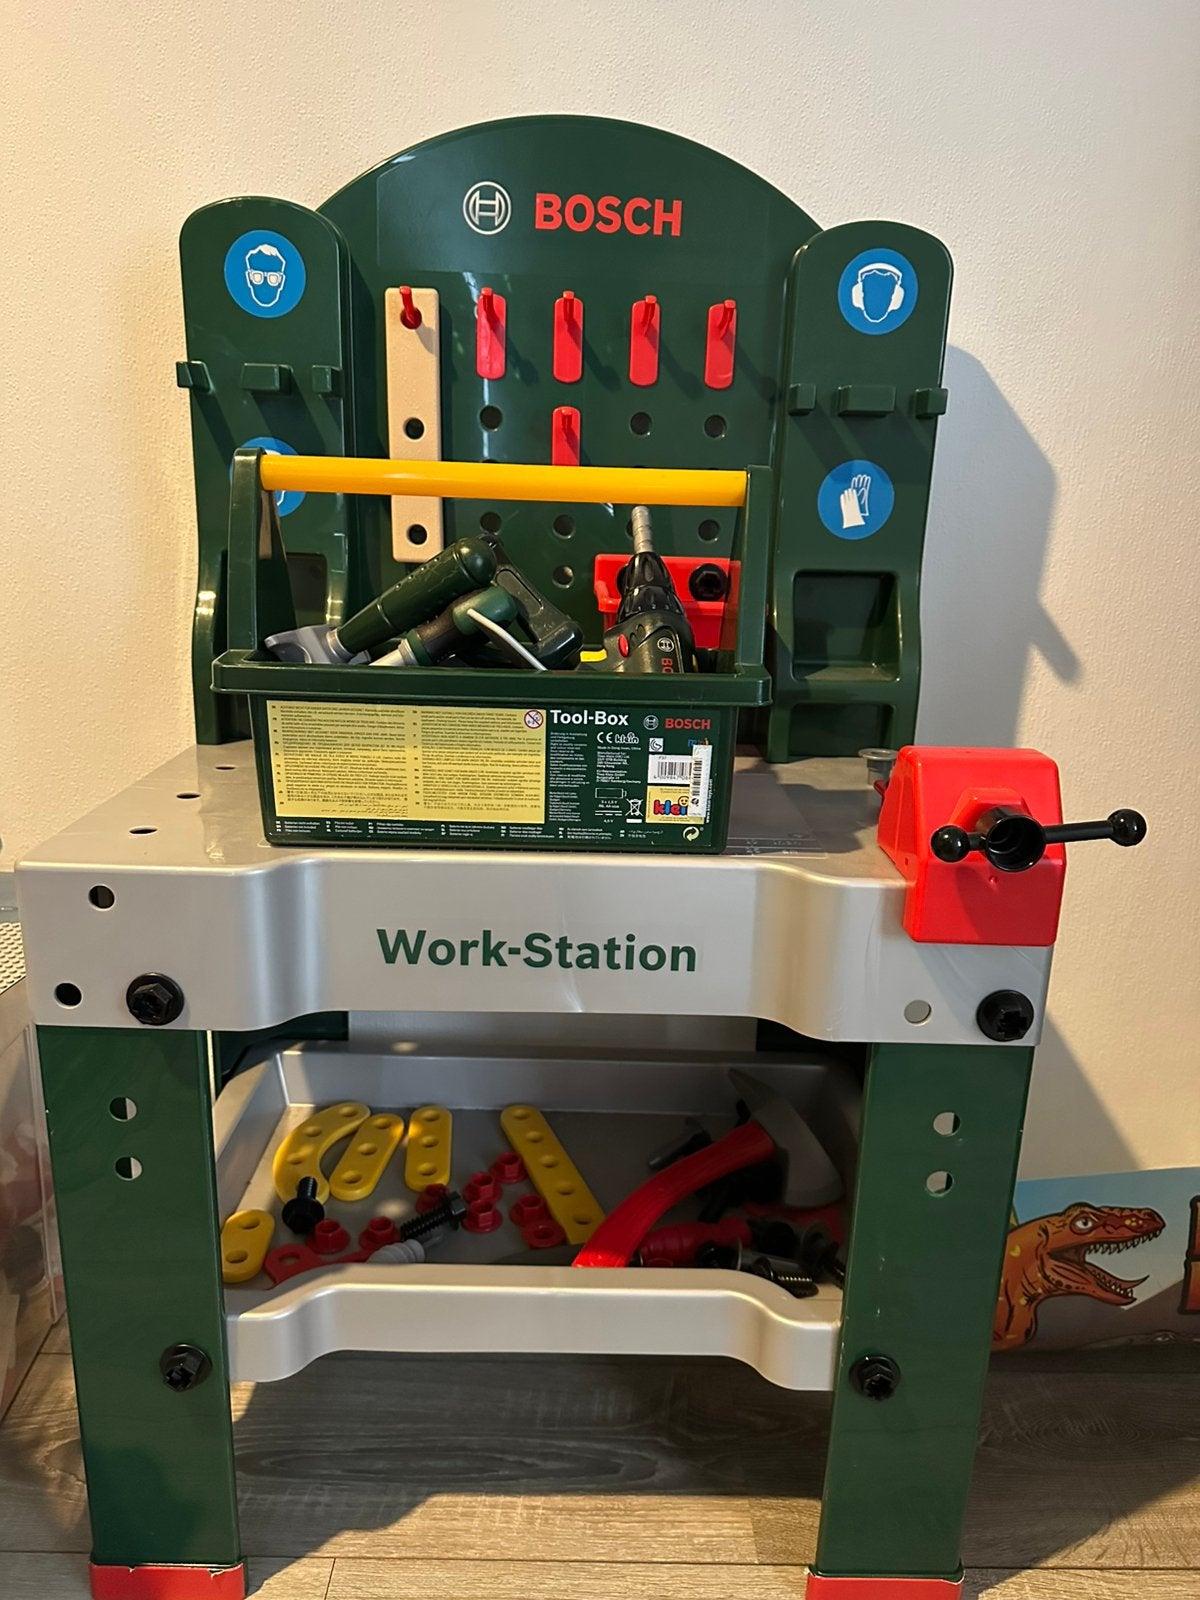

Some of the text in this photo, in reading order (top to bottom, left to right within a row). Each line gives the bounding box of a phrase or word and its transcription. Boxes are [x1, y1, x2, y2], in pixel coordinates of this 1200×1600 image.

[535, 192, 683, 237] BOSCH
[550, 709, 629, 726] Tool-Box
[665, 718, 711, 730] BOSCH
[614, 731, 640, 744] klein
[653, 796, 689, 816] klei
[376, 928, 697, 972] Work-Station
